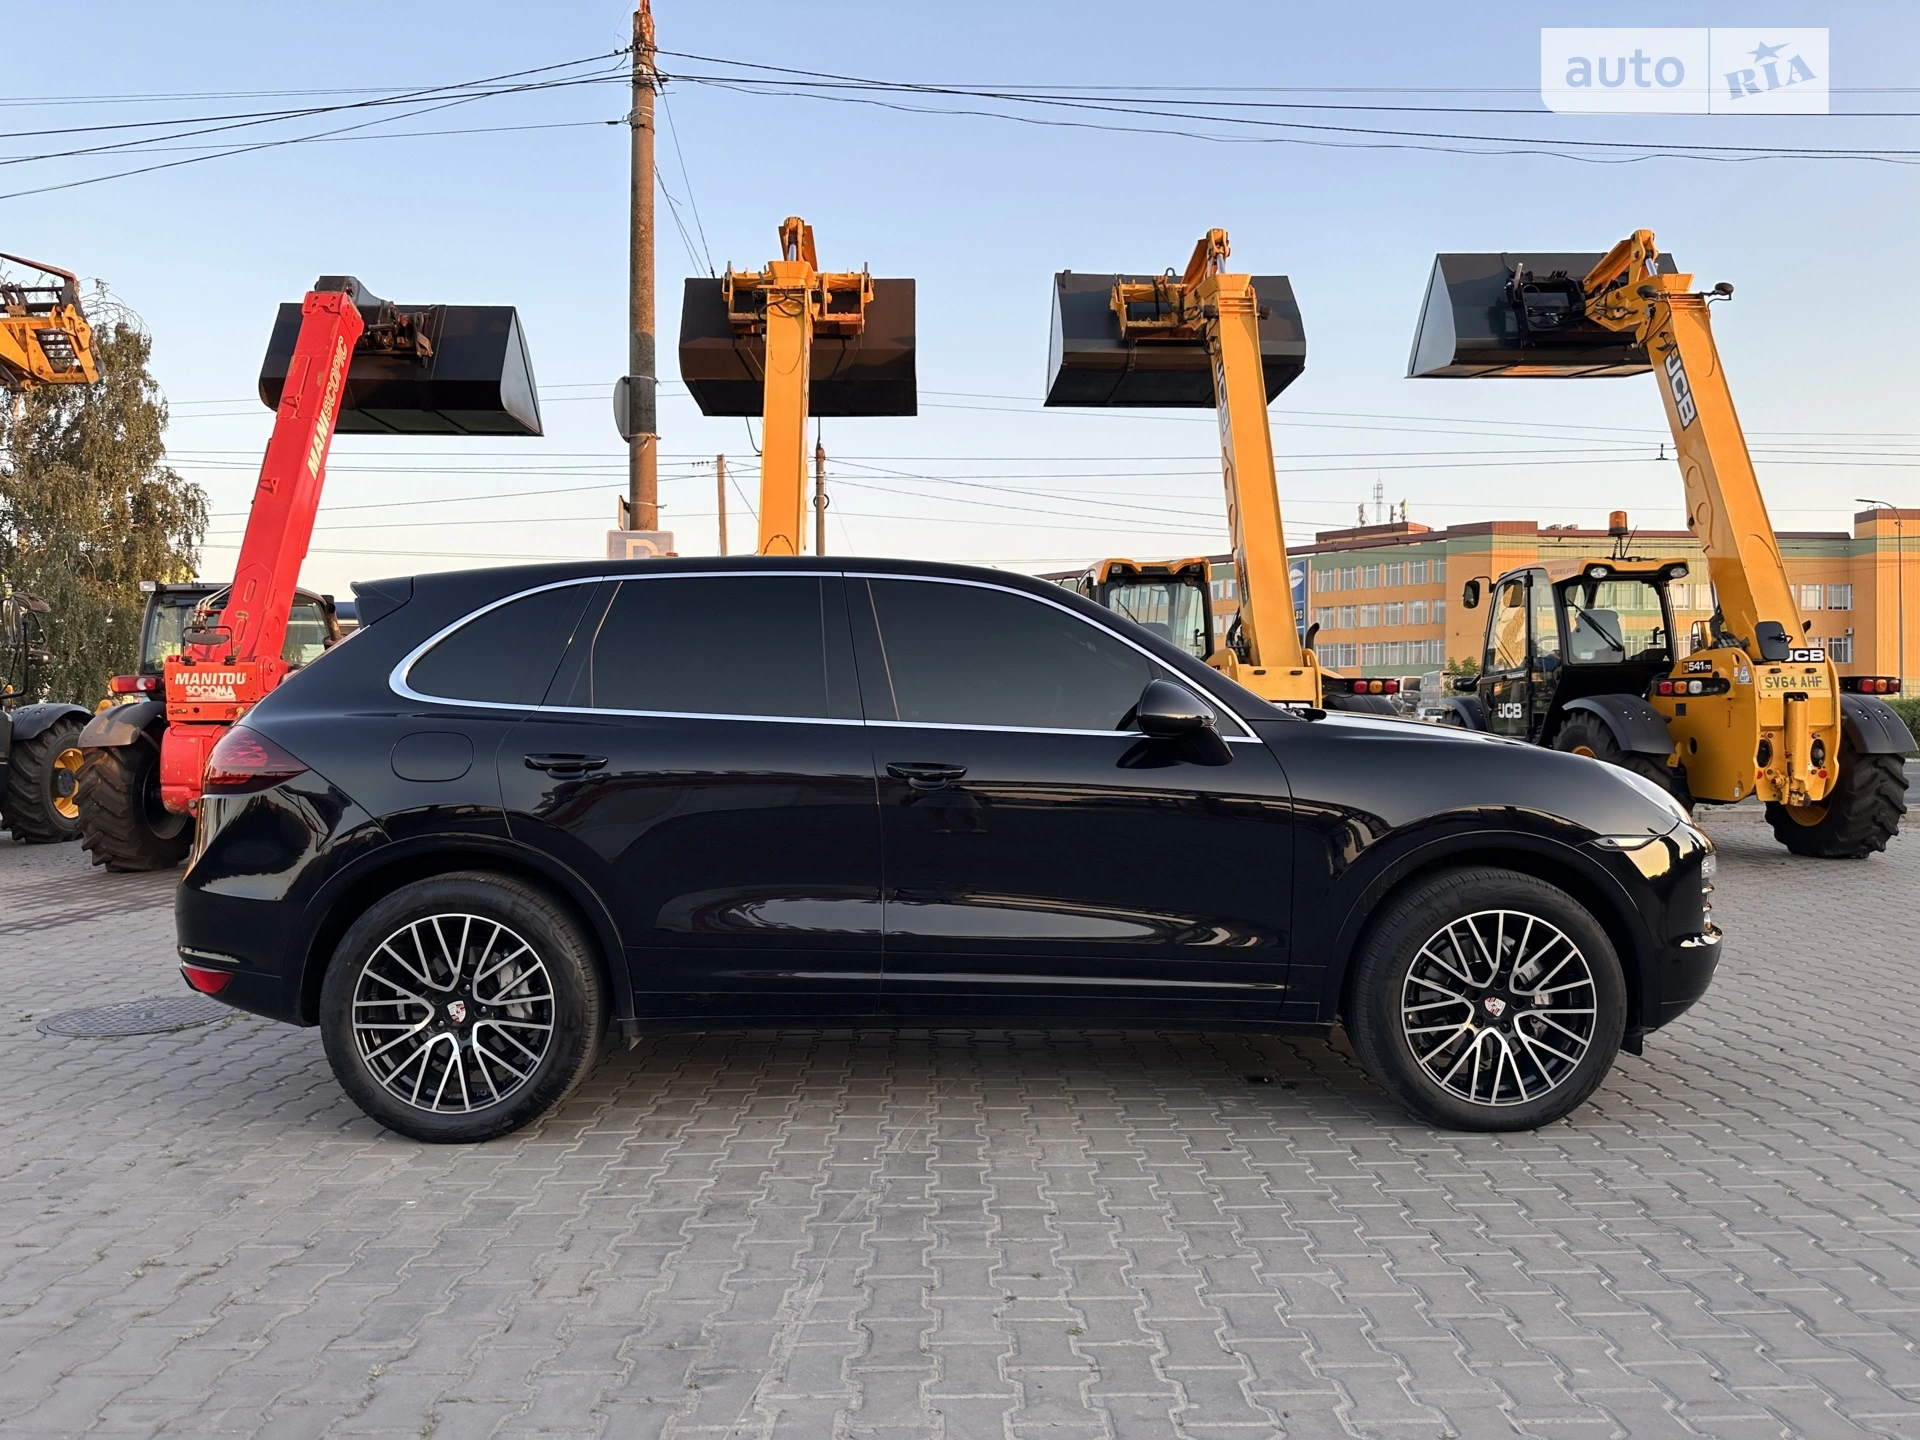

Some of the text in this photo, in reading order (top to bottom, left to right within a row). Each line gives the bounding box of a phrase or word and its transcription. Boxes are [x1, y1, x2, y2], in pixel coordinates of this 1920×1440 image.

[1665, 355, 1697, 428] JCB
[307, 335, 348, 480] MANISCOPIC
[1784, 650, 1825, 662] JCB
[174, 672, 247, 685] MANITOU
[1765, 675, 1823, 688] SV64 AHF
[185, 685, 236, 696] SOCOMA
[1498, 702, 1522, 718] JCB
